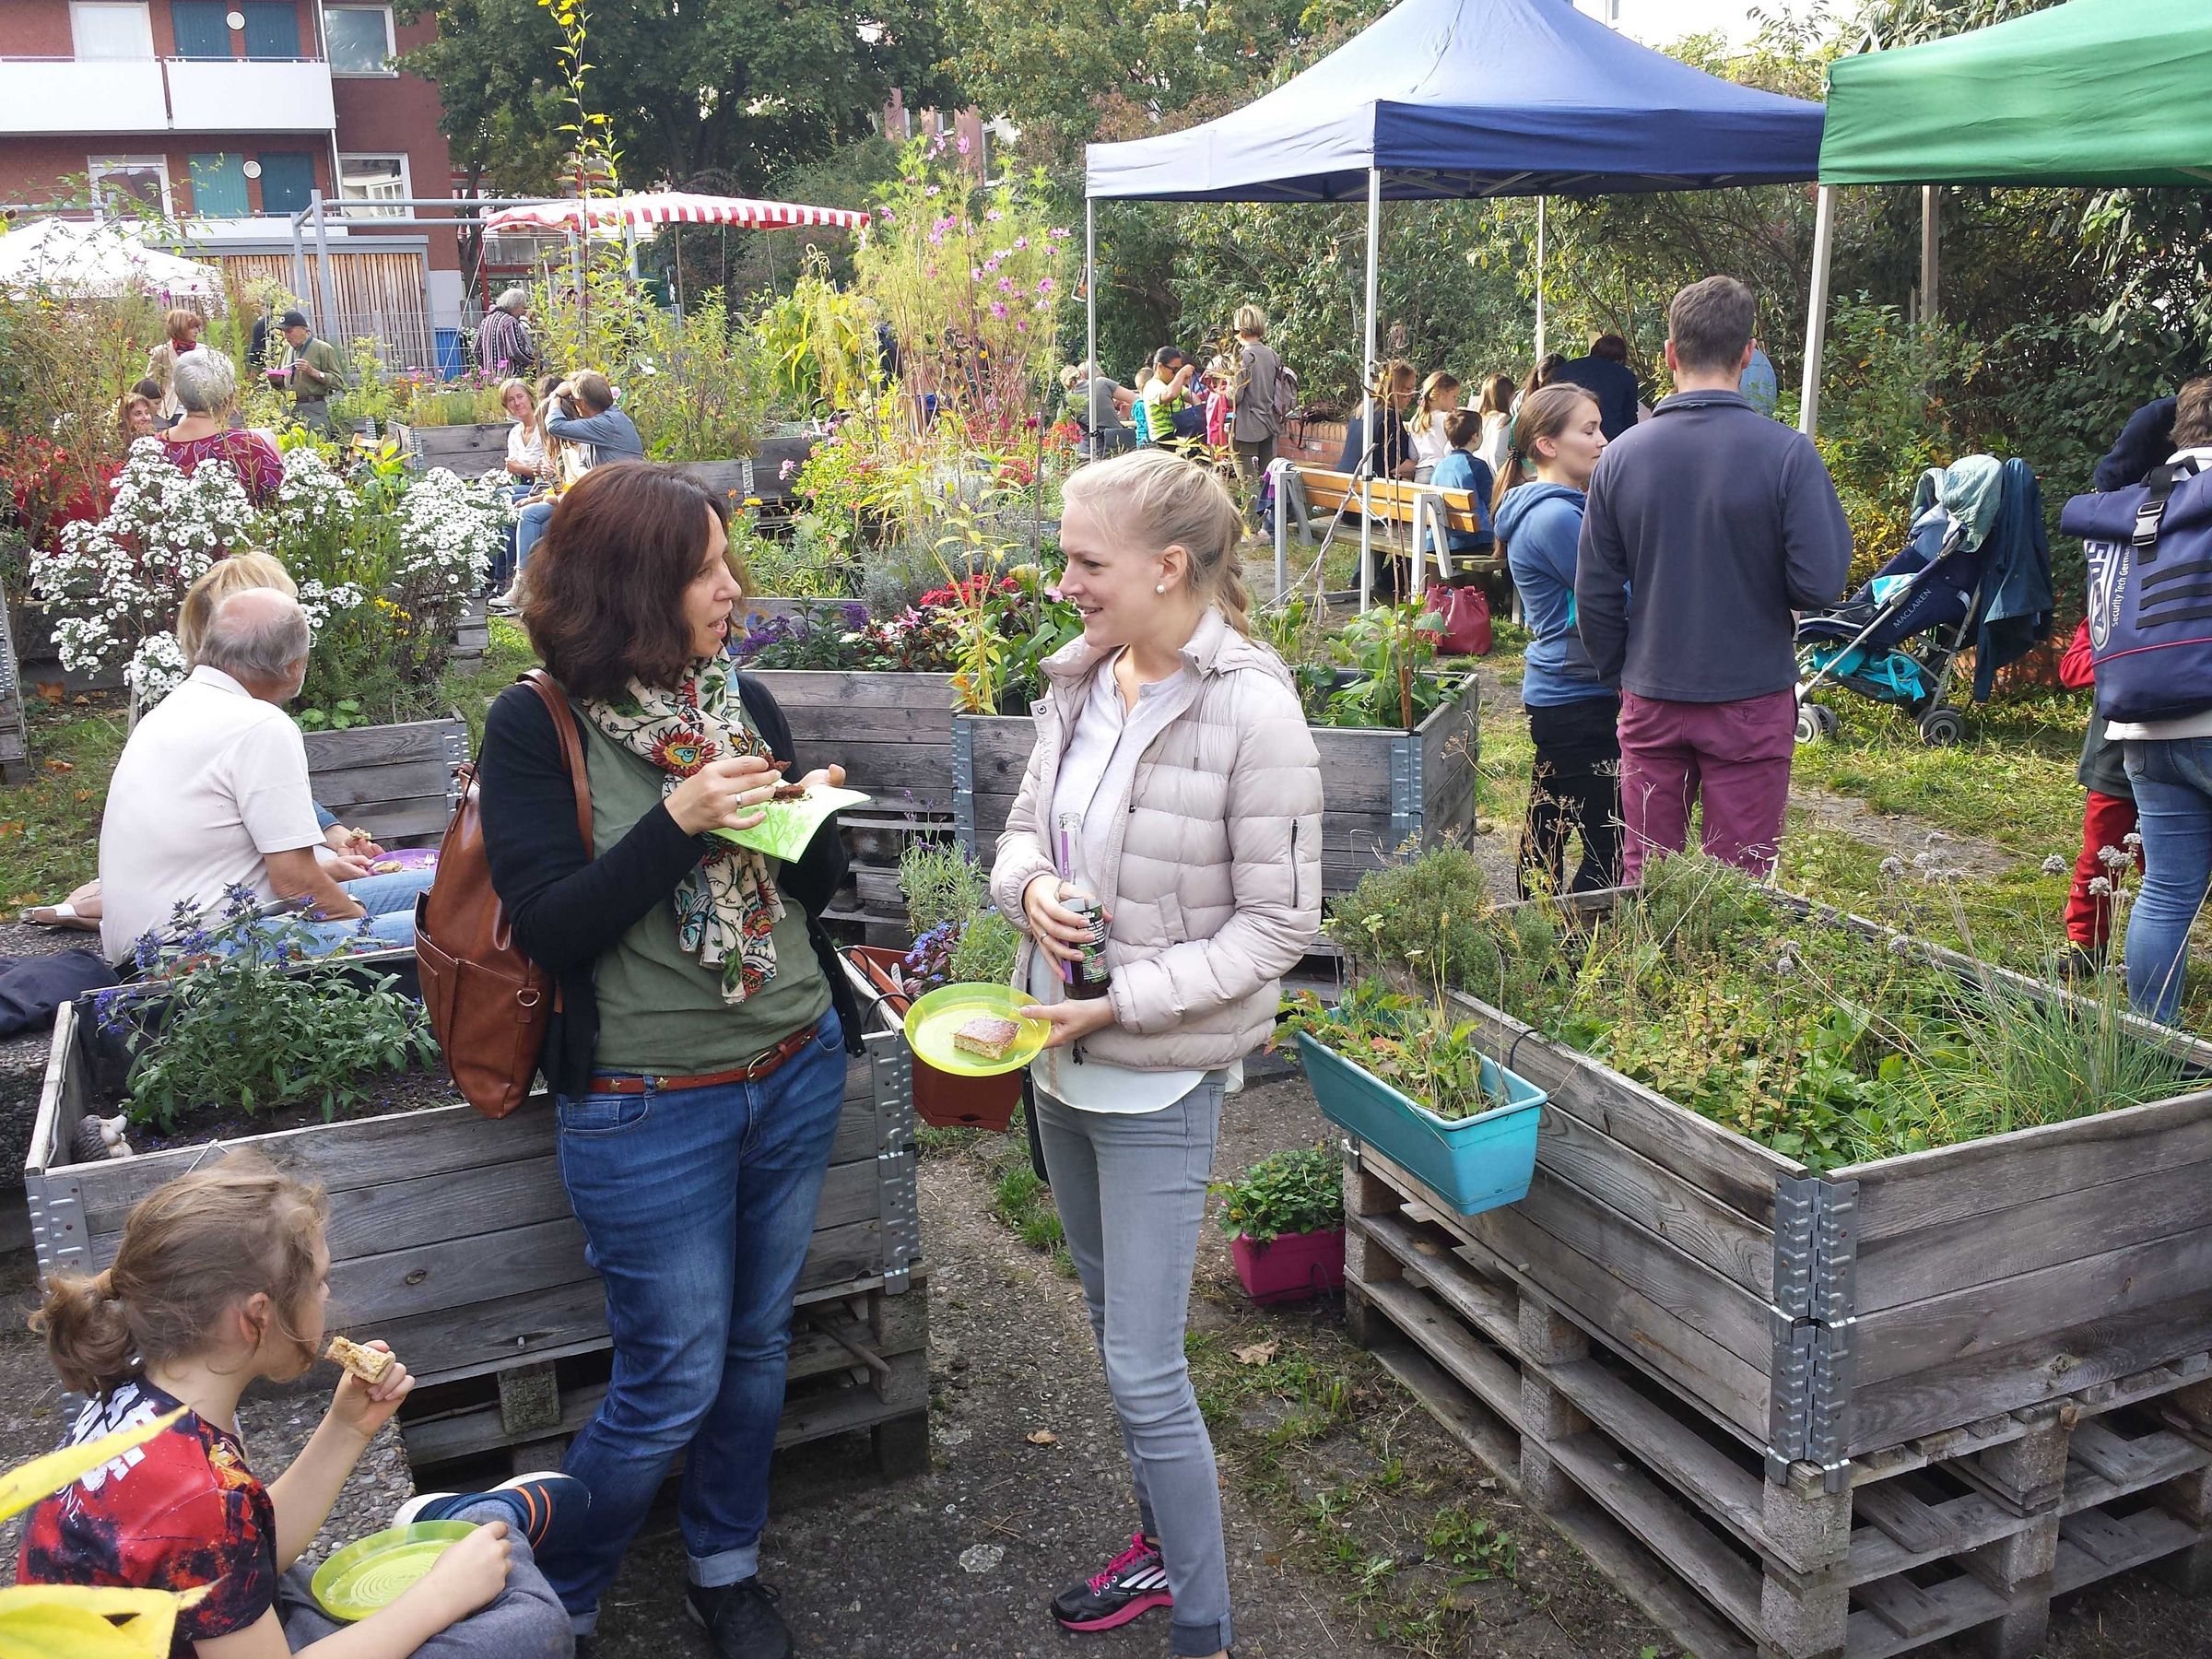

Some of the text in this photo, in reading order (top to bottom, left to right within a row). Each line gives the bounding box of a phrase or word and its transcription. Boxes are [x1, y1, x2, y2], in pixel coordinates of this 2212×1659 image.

[1893, 589, 1932, 628] MACLAREN
[2112, 547, 2131, 627] Security Tech German
